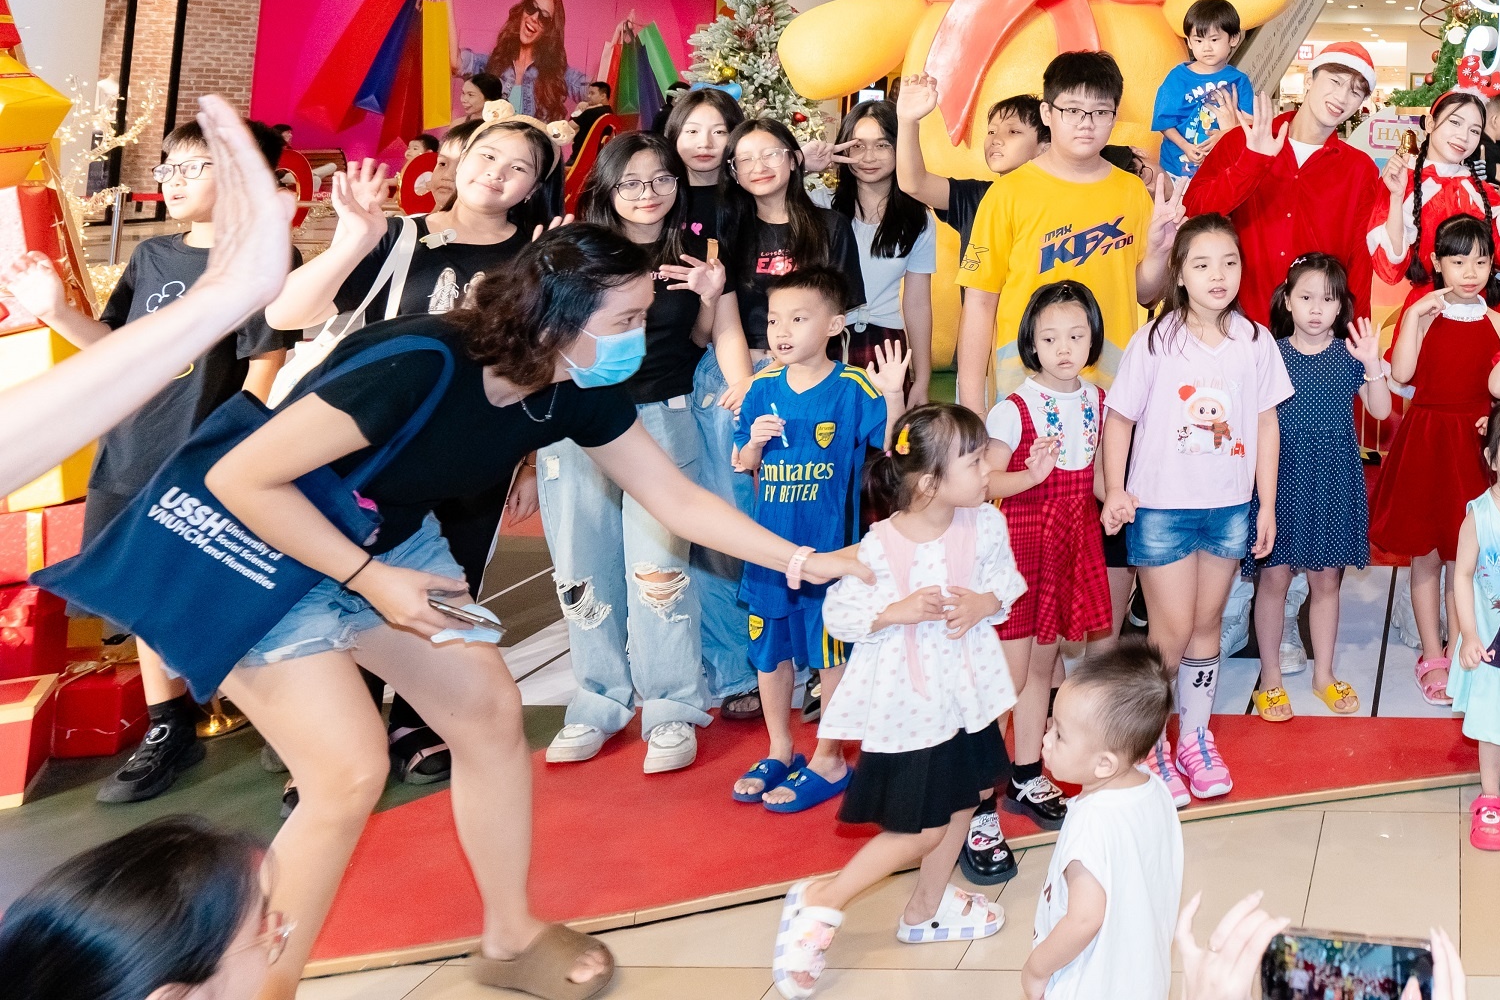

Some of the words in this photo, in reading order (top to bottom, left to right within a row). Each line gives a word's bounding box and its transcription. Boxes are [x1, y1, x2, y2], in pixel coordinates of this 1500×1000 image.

[1044, 223, 1073, 243] MAX
[1101, 235, 1134, 256] 700
[159, 486, 231, 538] USSH
[779, 483, 819, 503] BETTER
[147, 504, 212, 549] VNUHCM
[225, 522, 271, 556] University
[268, 552, 284, 561] of
[203, 545, 227, 560] and
[221, 555, 277, 590] Humanities
[214, 533, 242, 553] Social
[240, 549, 277, 574] Sciences
